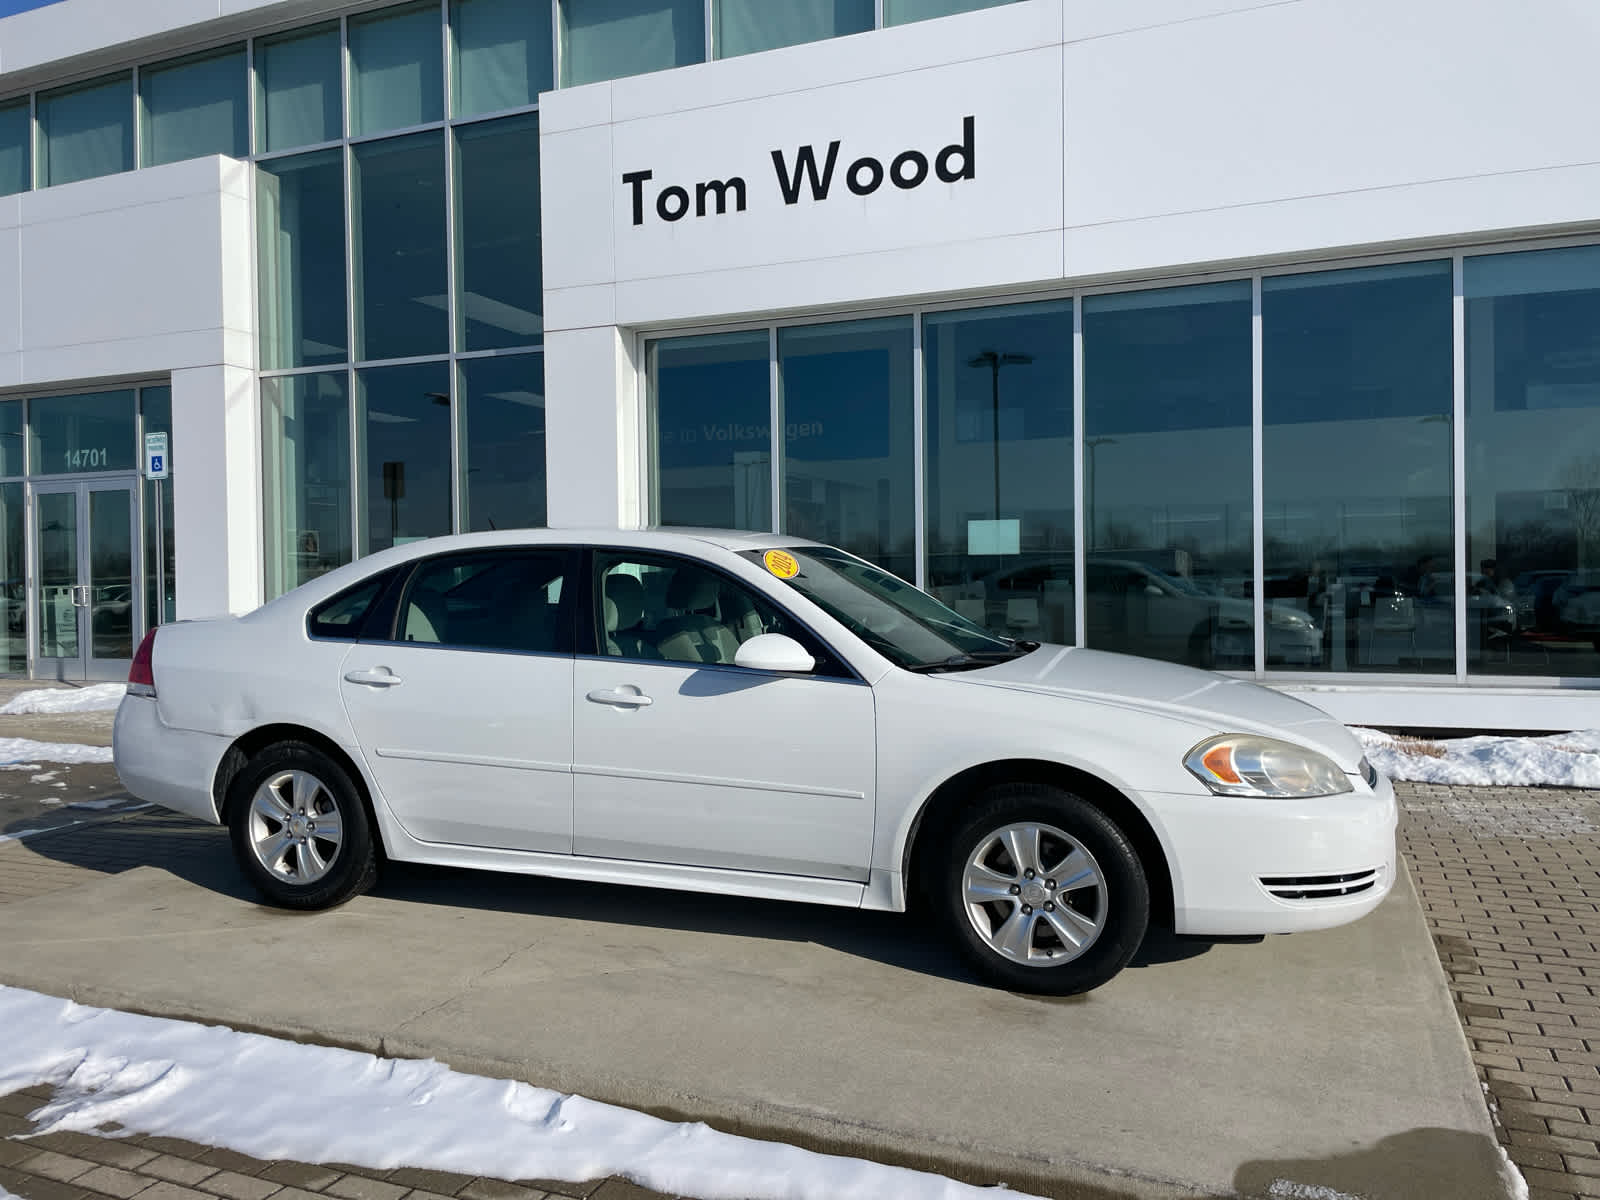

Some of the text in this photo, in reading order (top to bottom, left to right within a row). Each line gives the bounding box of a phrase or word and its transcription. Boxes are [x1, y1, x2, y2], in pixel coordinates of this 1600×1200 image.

[622, 115, 975, 226] Tom Wood
[703, 421, 823, 441] Volkswgen
[64, 447, 107, 469] 14701
